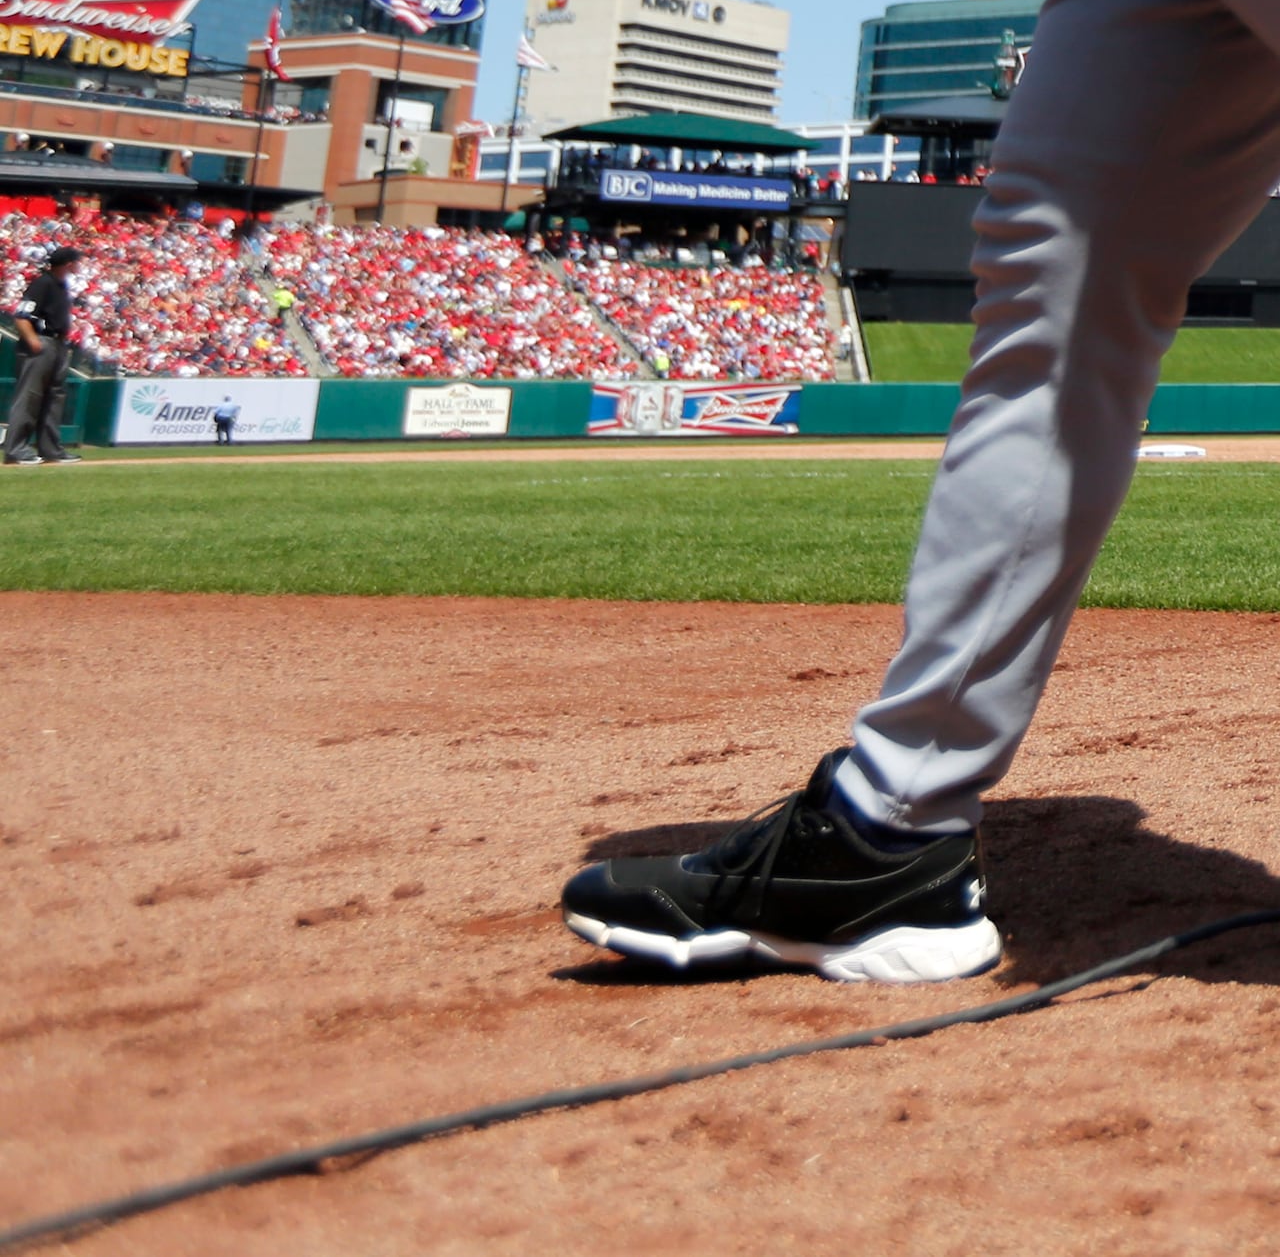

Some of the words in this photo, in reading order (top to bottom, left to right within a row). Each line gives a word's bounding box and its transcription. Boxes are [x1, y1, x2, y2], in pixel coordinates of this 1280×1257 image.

[71, 35, 191, 77] HOUSE
[609, 175, 646, 197] BJC
[653, 181, 697, 199] Making
[700, 183, 751, 200] Medicine
[753, 185, 788, 202] Better
